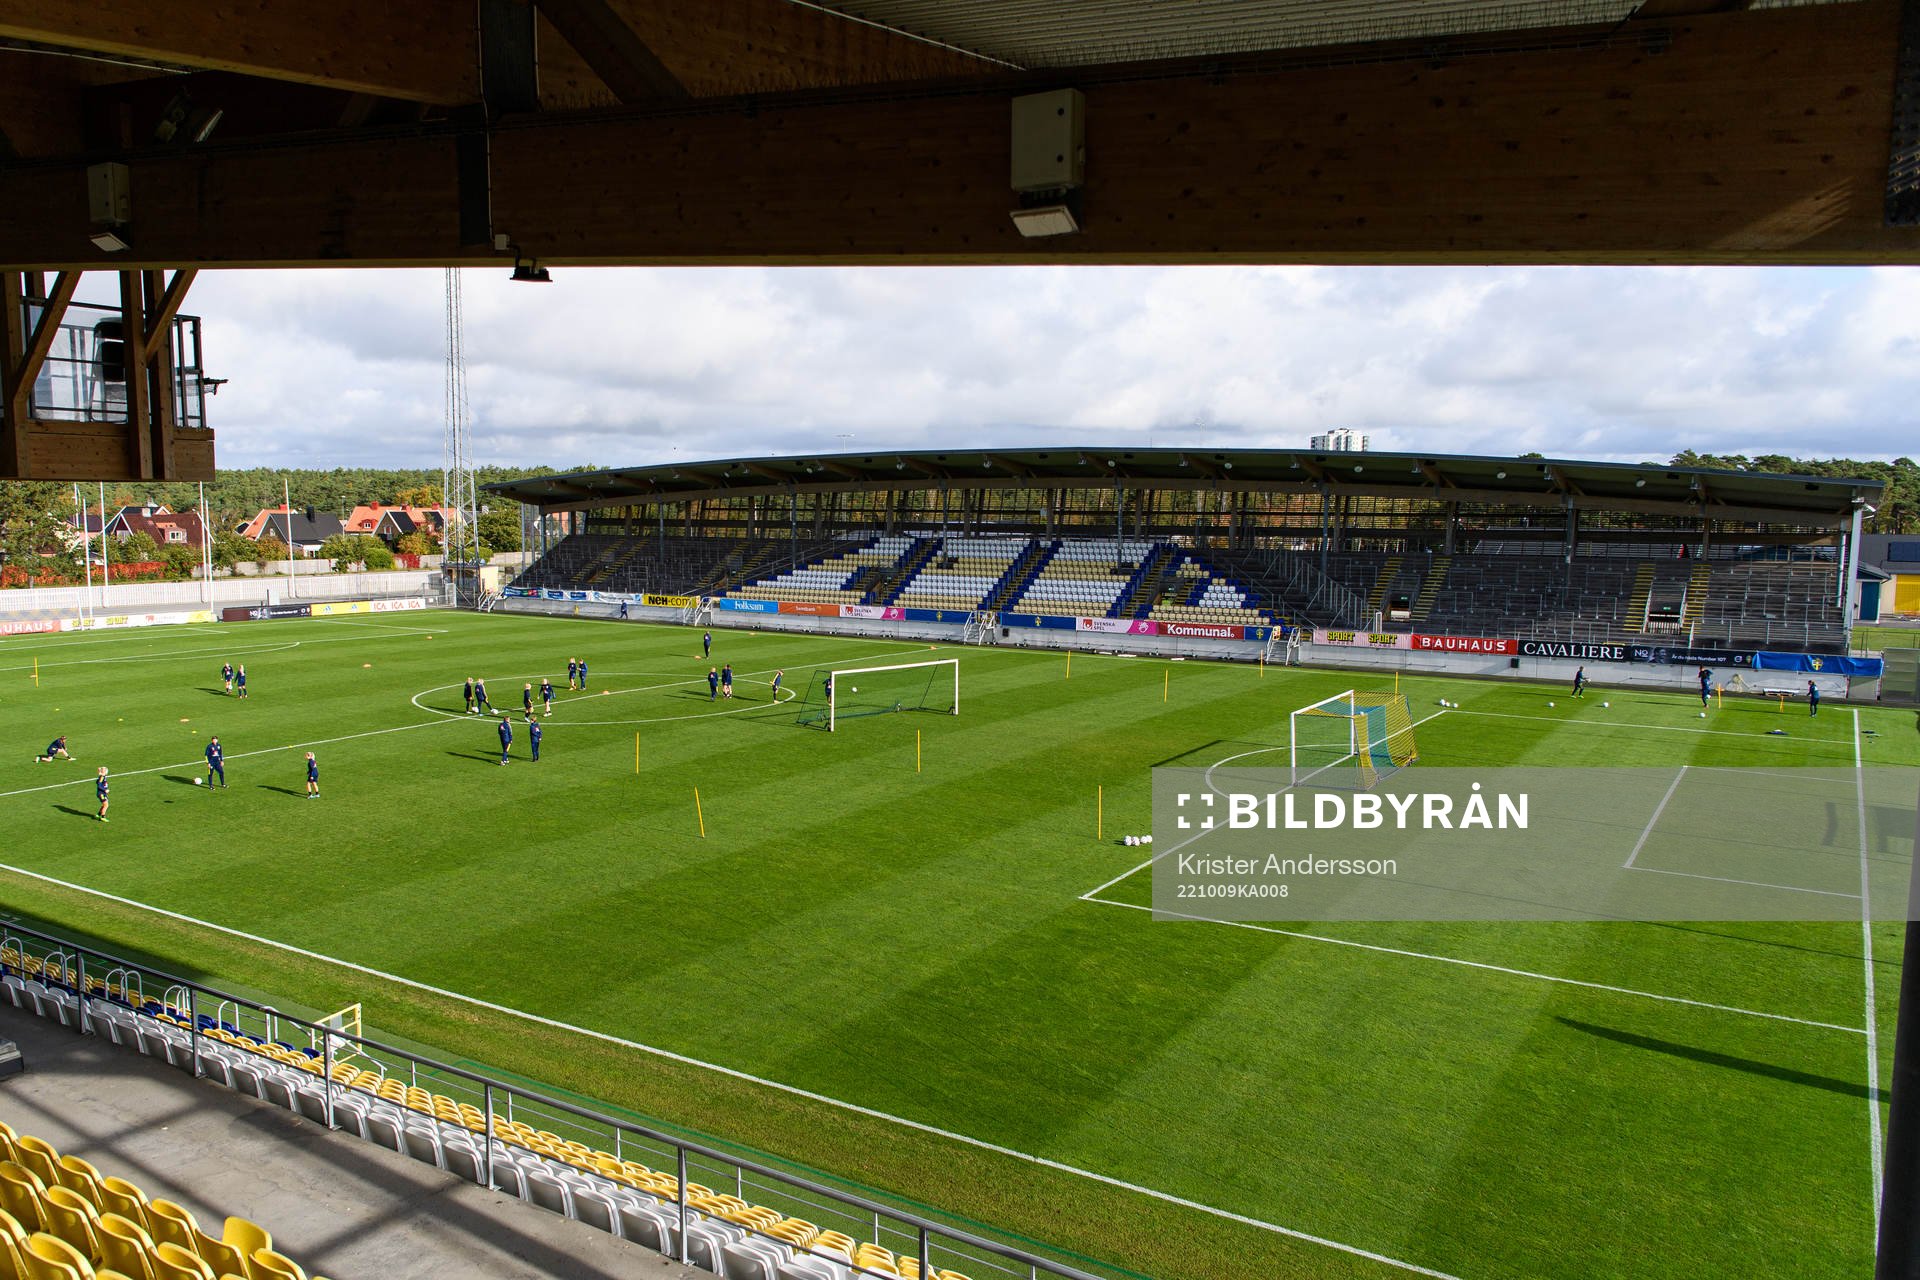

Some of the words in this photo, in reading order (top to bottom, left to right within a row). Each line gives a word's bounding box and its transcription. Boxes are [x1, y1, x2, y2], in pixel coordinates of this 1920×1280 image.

[374, 602, 387, 611] ICA
[391, 601, 404, 610] ICA
[408, 600, 421, 609] ICA
[735, 600, 764, 611] Folksam
[0, 622, 53, 633] UHAUS
[1327, 631, 1356, 642] SPORT
[1368, 633, 1398, 644] SPORT
[1422, 637, 1506, 652] BAUHAUS
[1524, 642, 1624, 660] CAVALIERE
